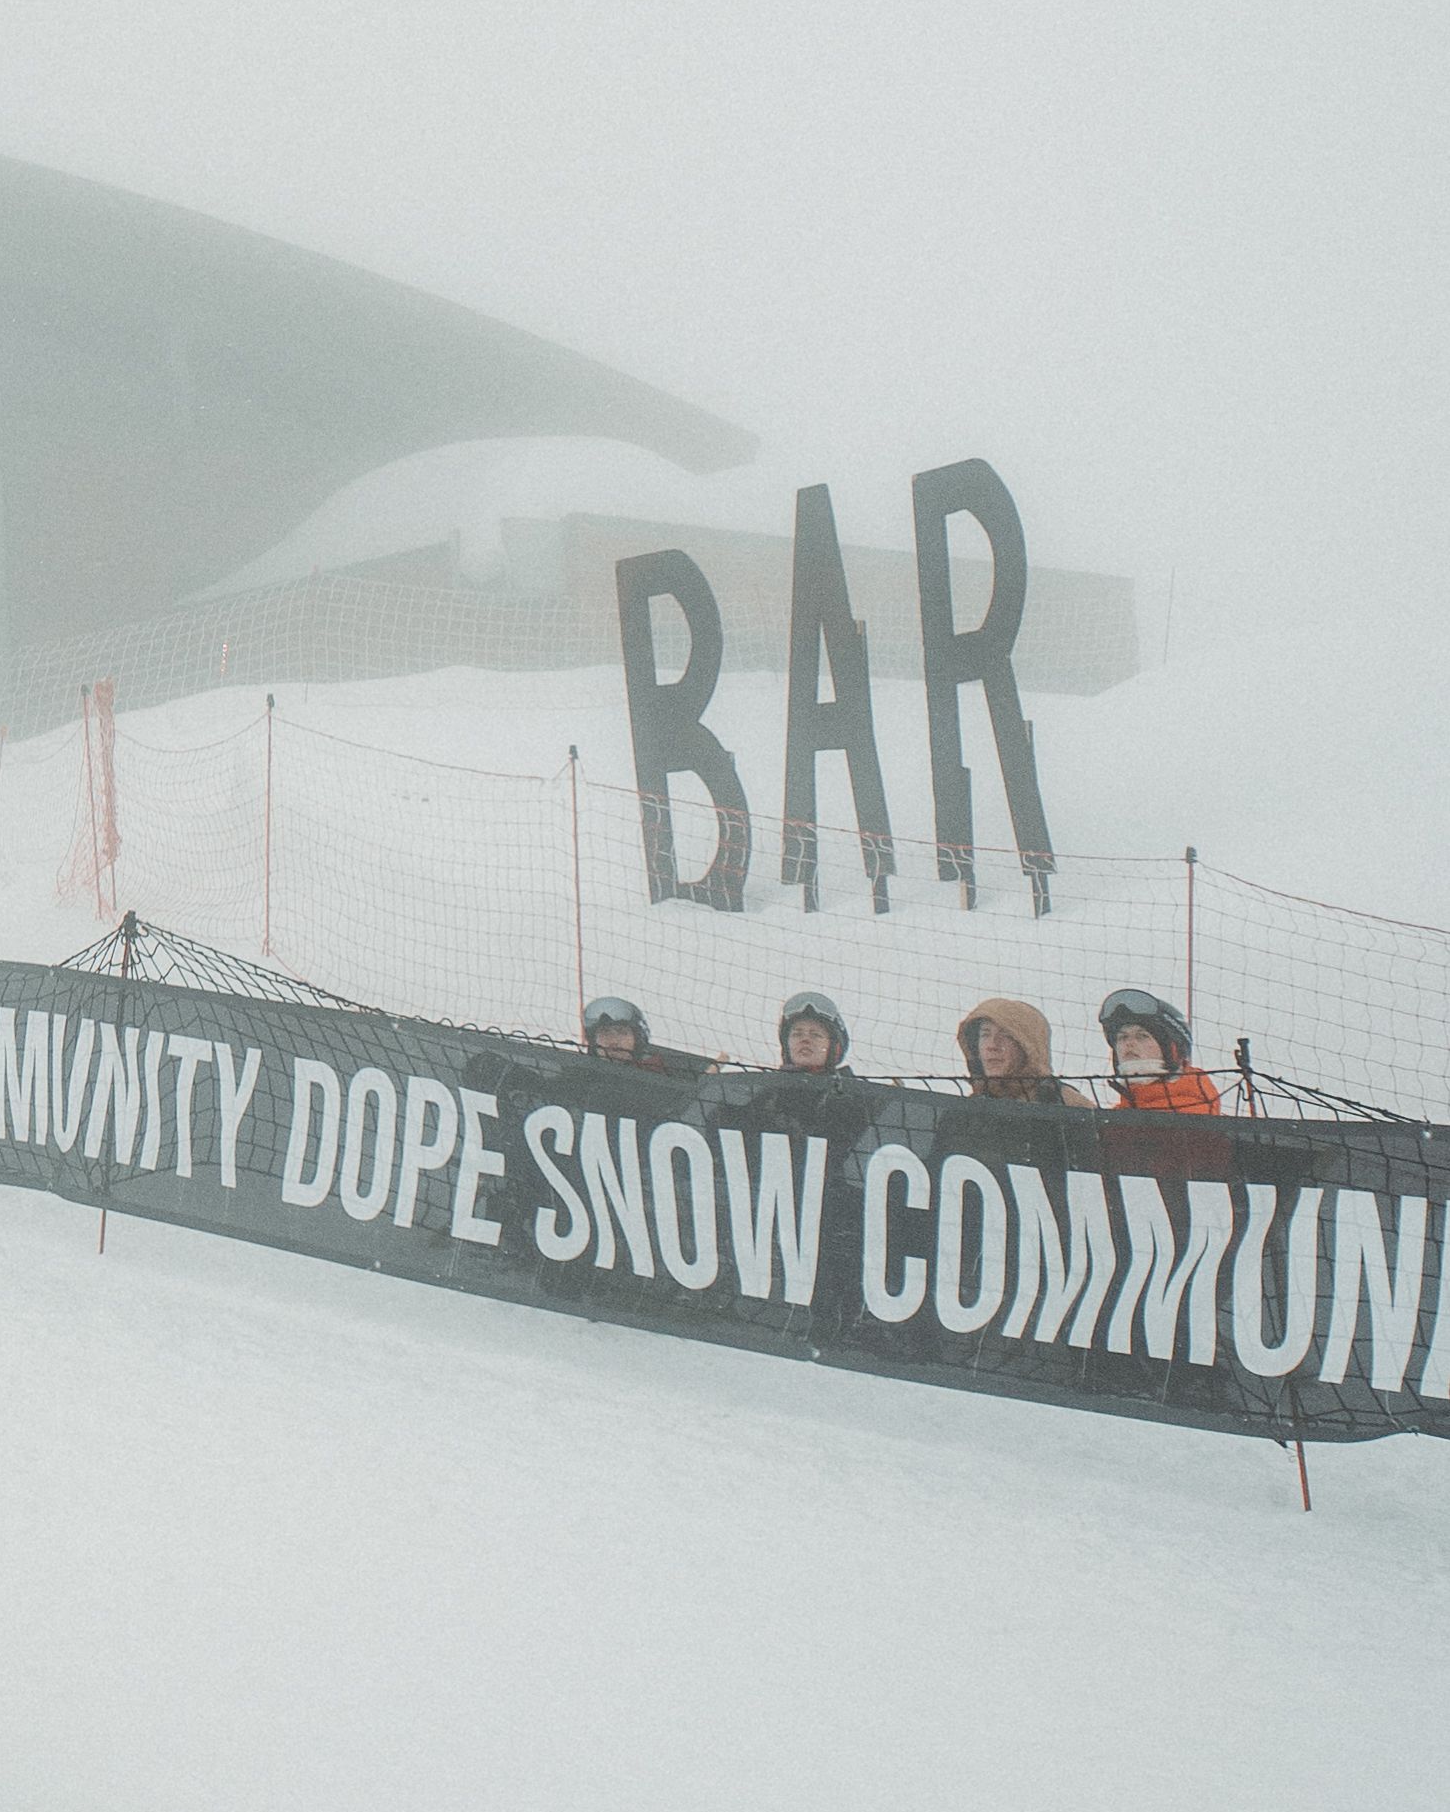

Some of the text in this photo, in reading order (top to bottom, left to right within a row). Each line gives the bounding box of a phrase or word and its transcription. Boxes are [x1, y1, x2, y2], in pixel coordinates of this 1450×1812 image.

[614, 457, 1057, 916] BAR
[281, 1055, 507, 1248] DOPE
[522, 1104, 829, 1307] SNOW
